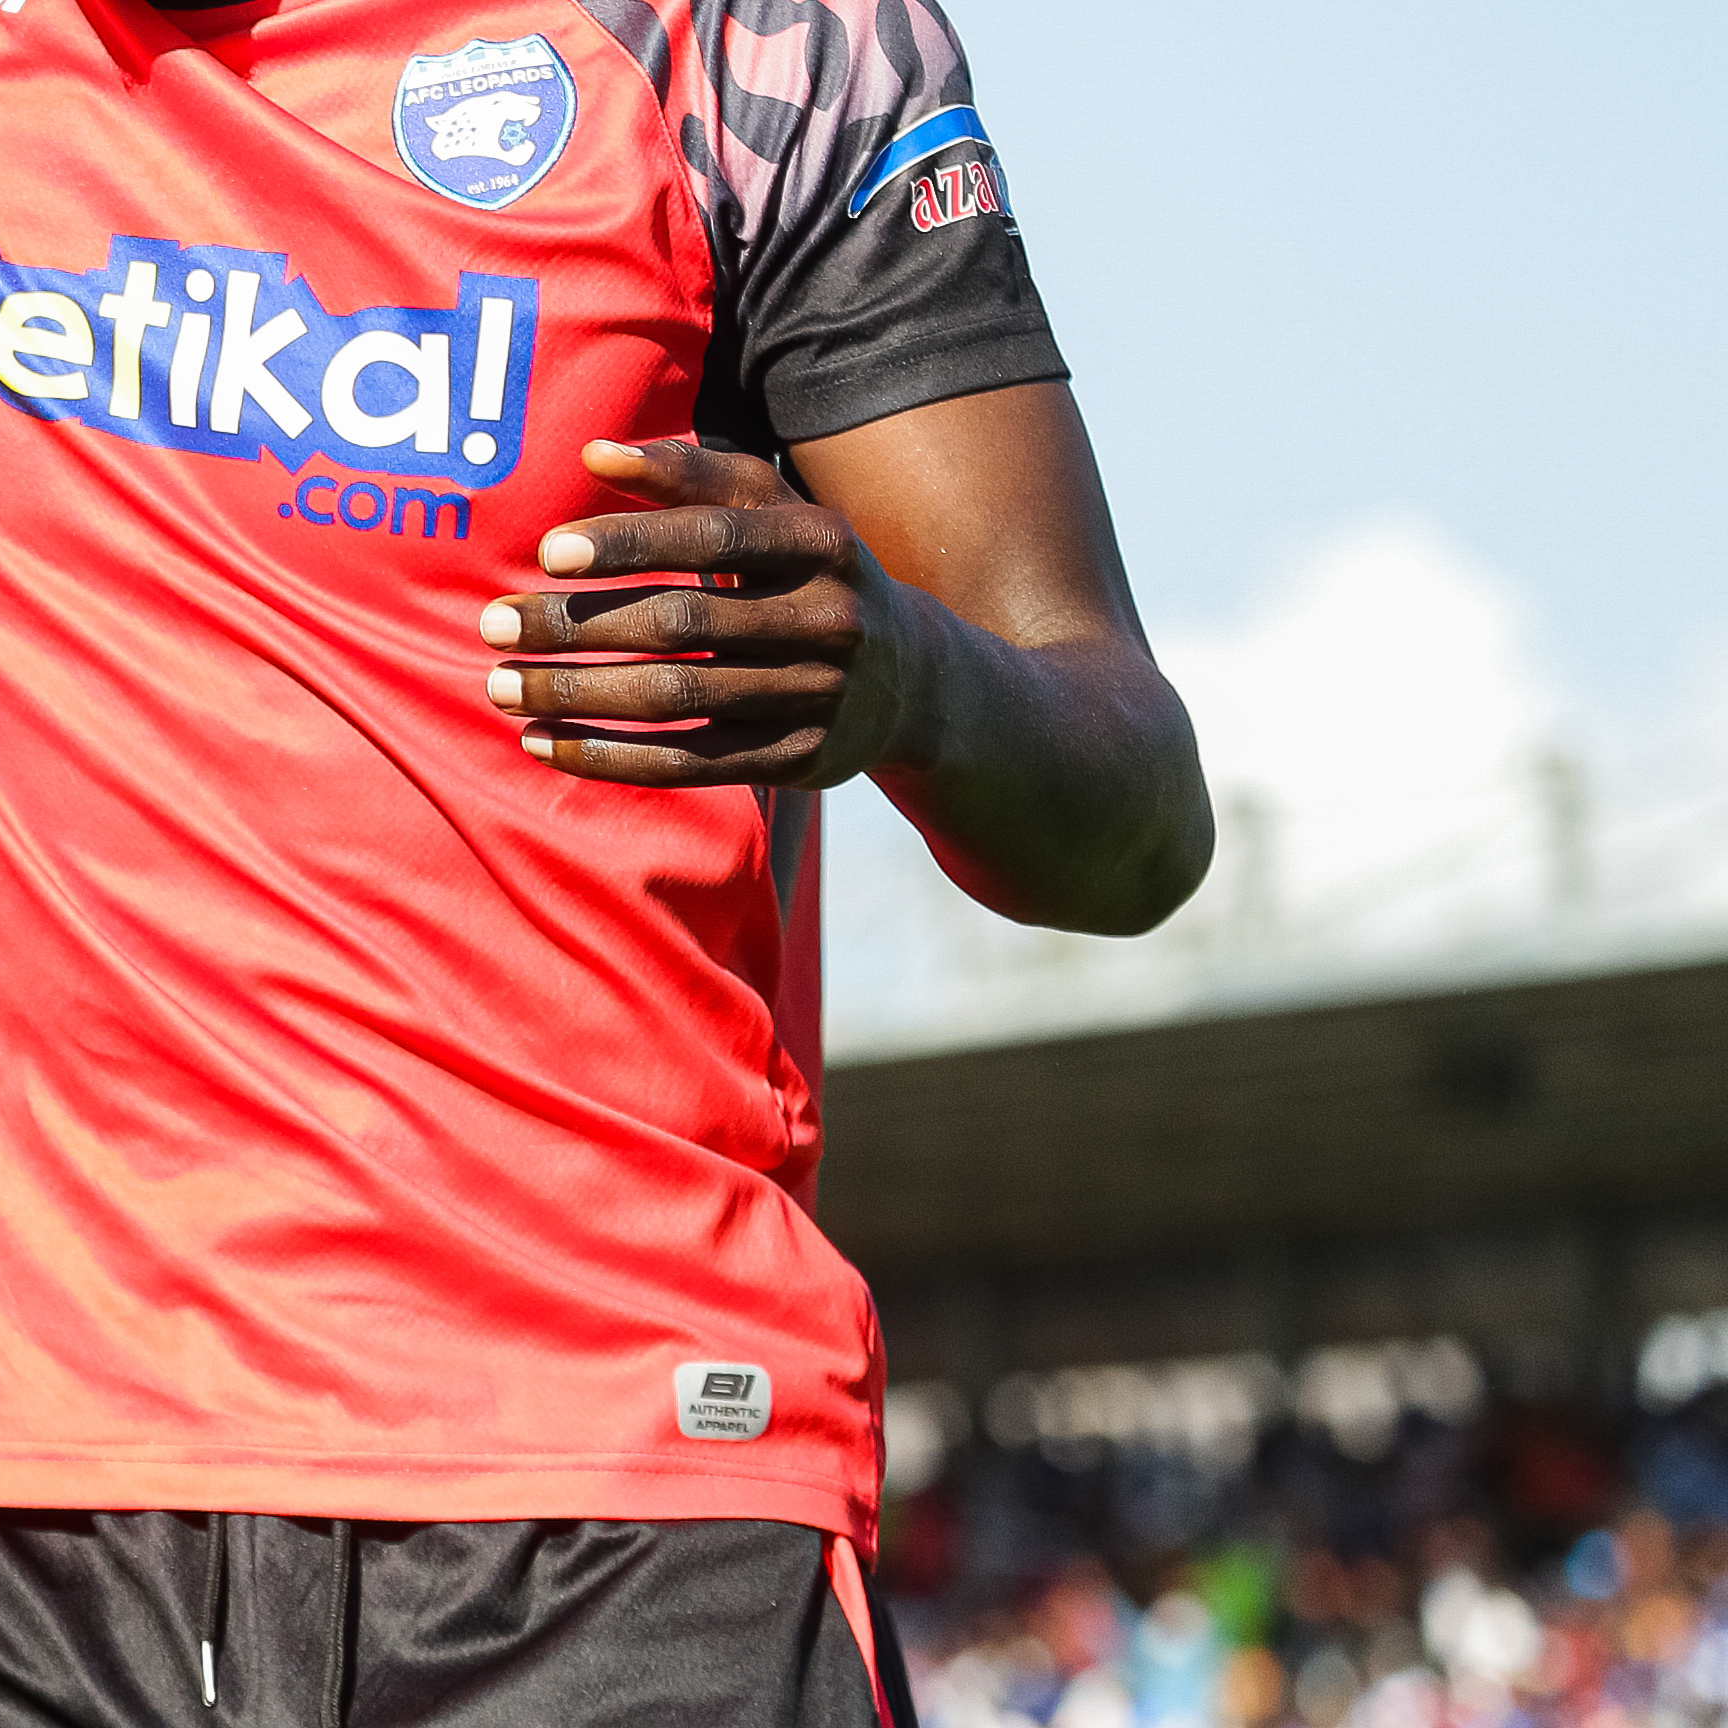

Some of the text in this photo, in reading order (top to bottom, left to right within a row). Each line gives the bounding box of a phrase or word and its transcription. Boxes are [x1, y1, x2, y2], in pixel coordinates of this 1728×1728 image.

[404, 66, 555, 107] AFC LEOPARDS
[278, 475, 471, 540] .com
[689, 1404, 762, 1419] AUTHENTIC
[696, 1420, 750, 1433] APPAREL
